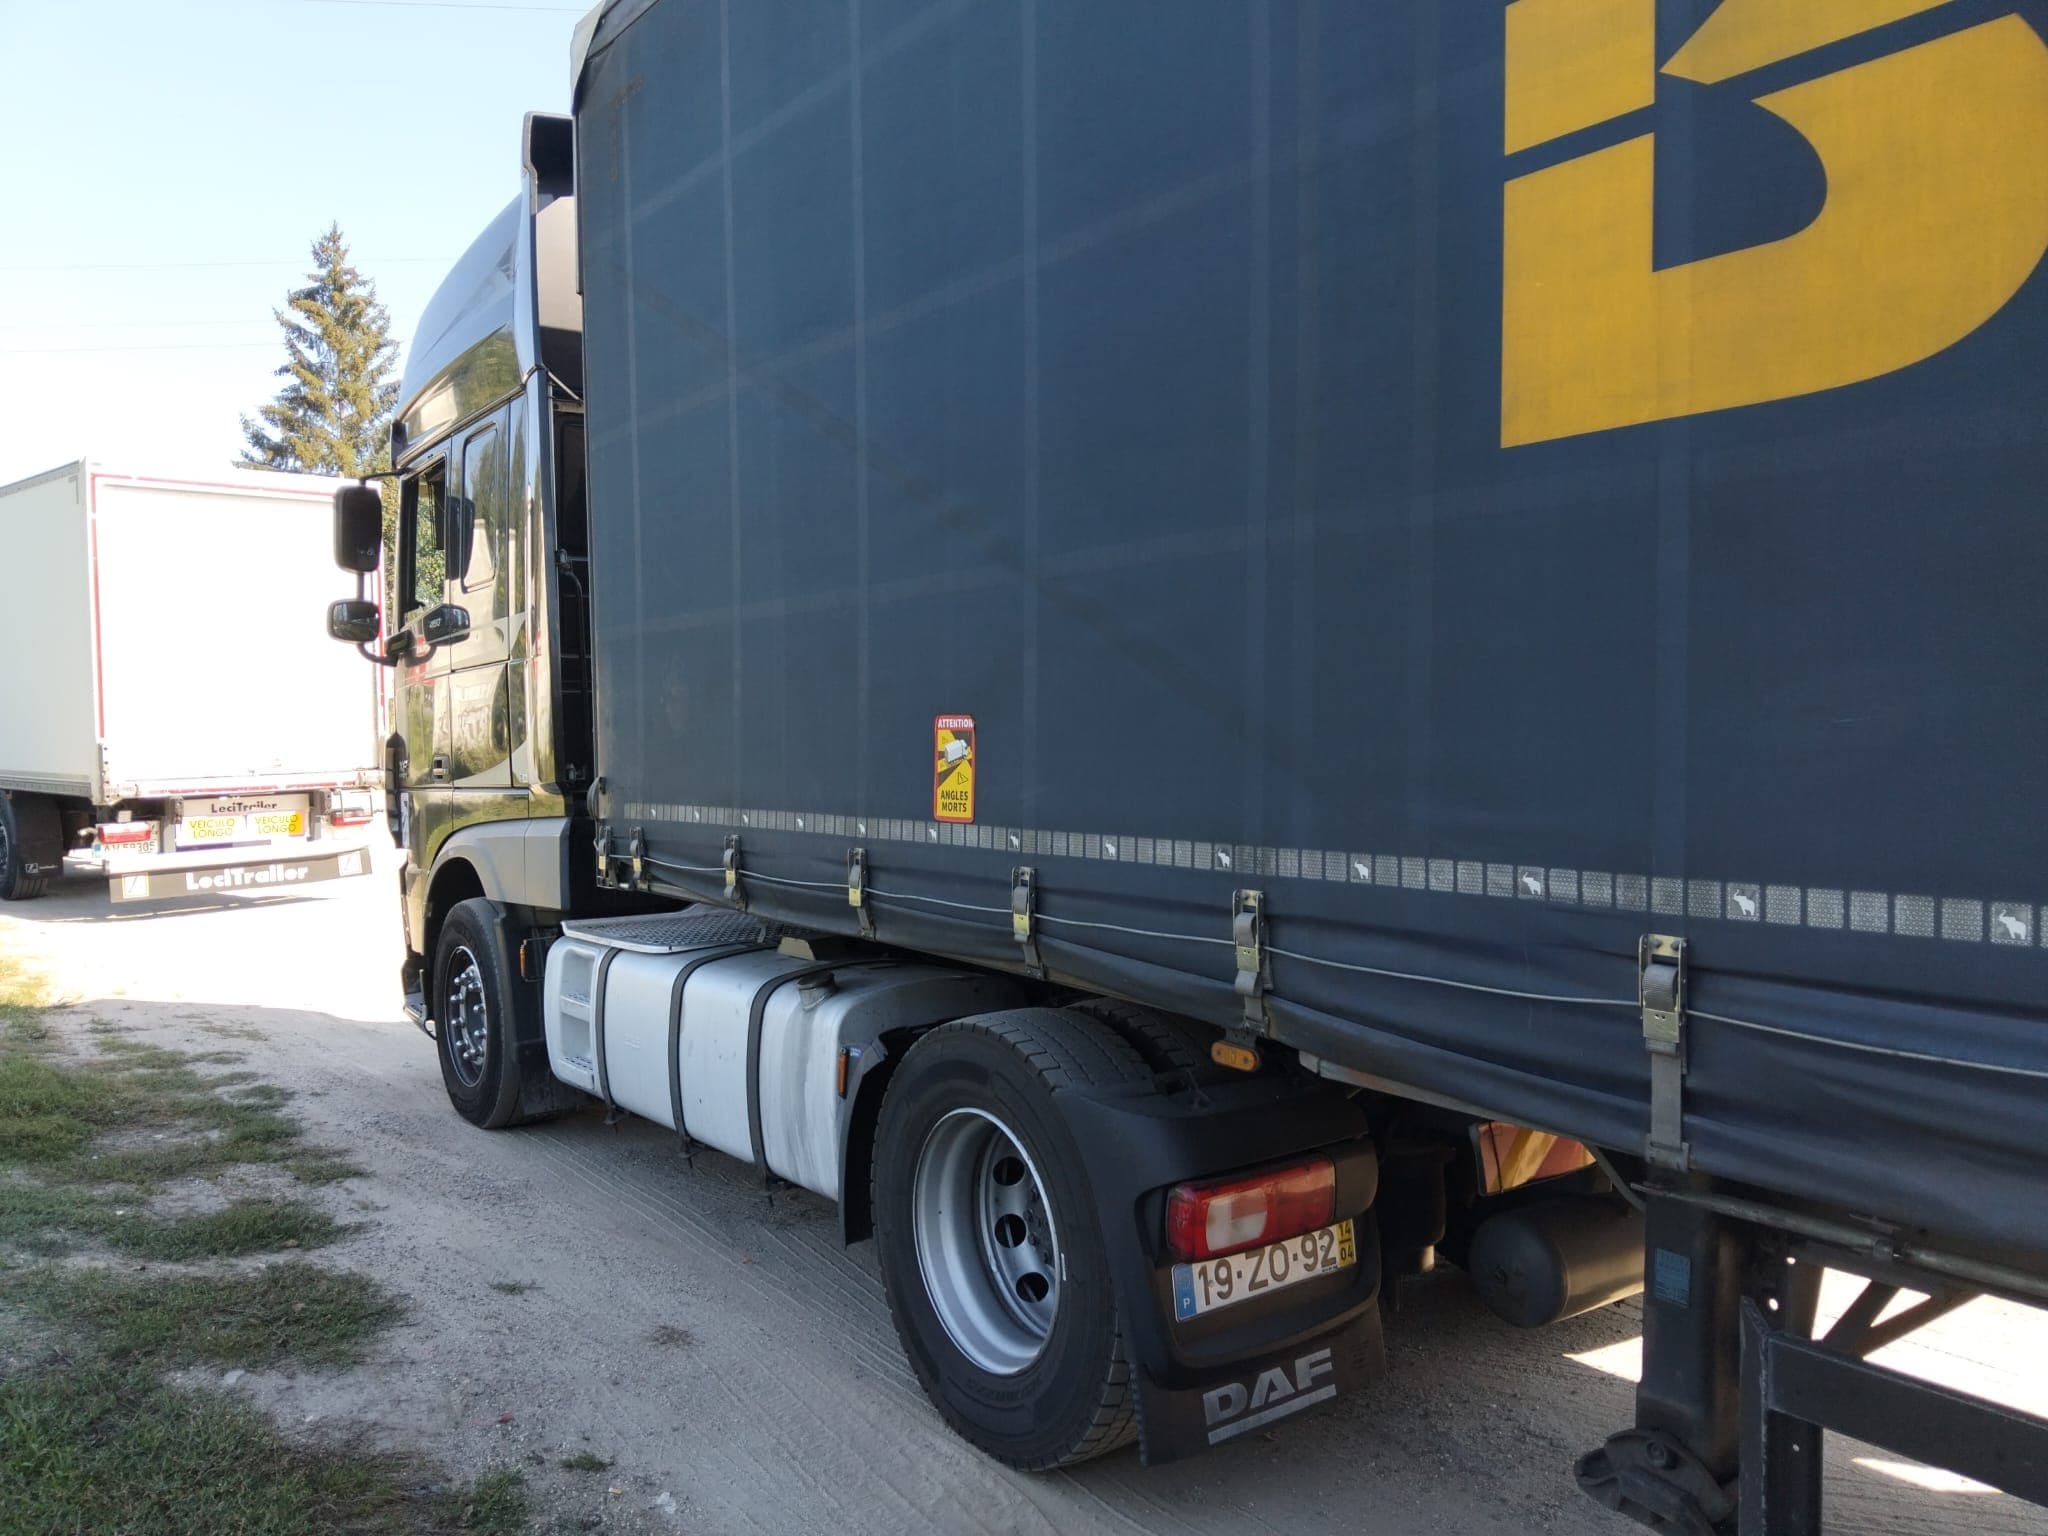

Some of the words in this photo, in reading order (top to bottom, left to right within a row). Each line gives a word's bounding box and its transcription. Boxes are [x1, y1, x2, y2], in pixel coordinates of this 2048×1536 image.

[938, 719, 973, 728] ATTENTION
[941, 790, 969, 801] ANGLES
[942, 802, 967, 813] MORTS
[193, 828, 233, 839] LONGO
[258, 823, 297, 834] LONGO
[185, 863, 308, 890] LeciTrailer
[1203, 1347, 1333, 1426] DAF
